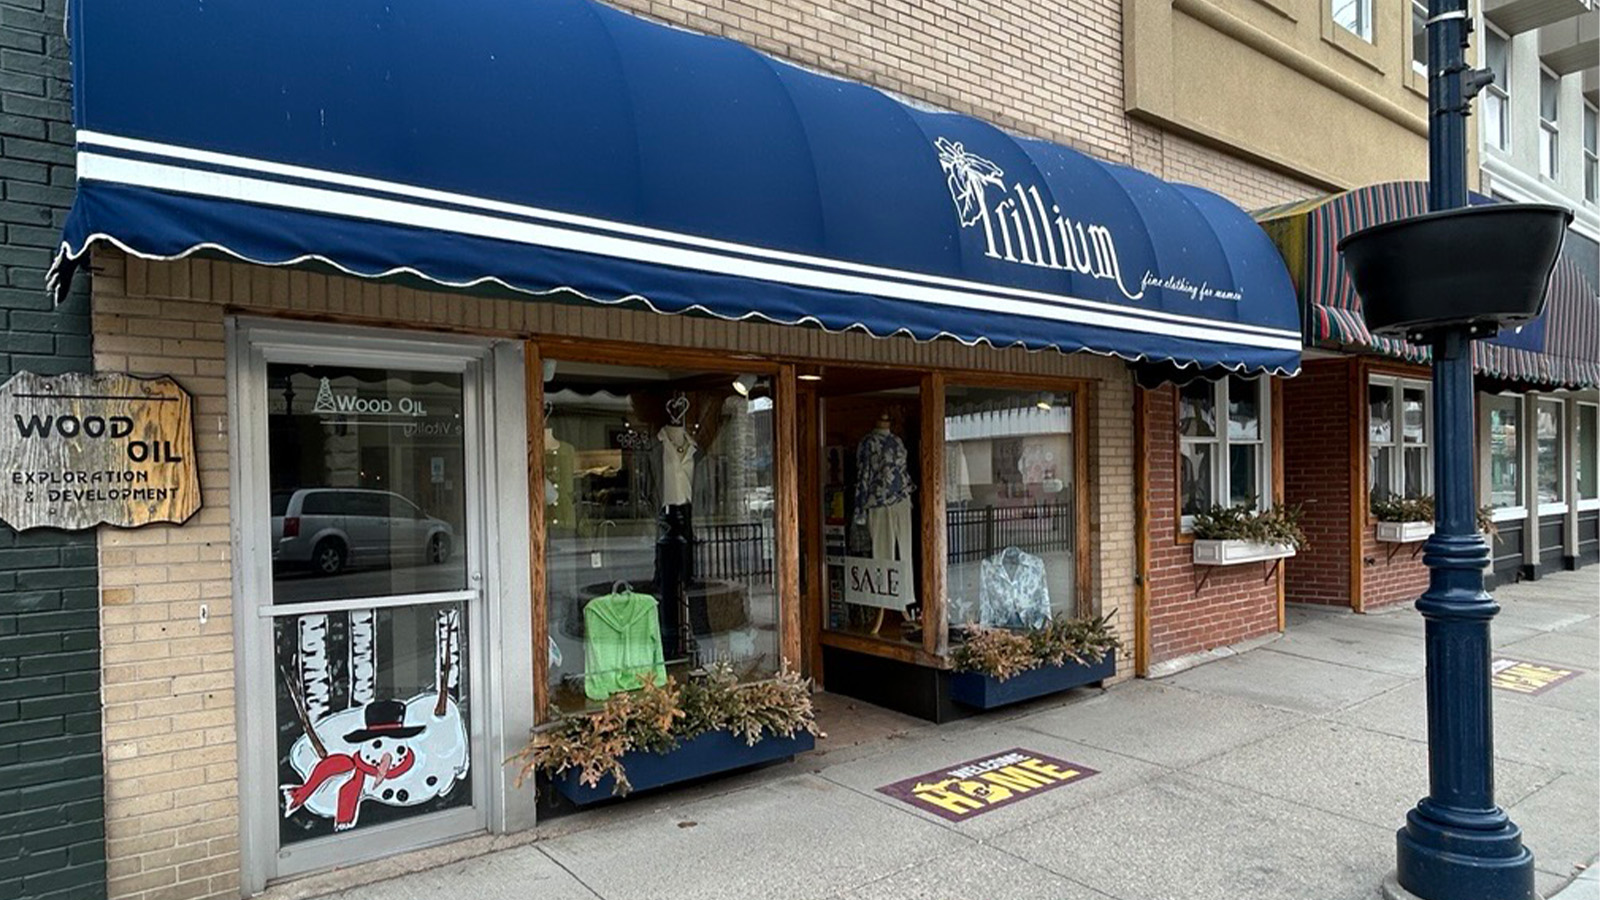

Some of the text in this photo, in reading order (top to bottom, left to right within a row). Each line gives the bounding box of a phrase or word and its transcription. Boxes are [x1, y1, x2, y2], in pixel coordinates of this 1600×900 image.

[950, 166, 1143, 300] Trillium
[1141, 269, 1163, 291] fine
[1163, 275, 1198, 300] clothing
[1199, 281, 1213, 301] for
[14, 414, 134, 438] WOOD
[127, 441, 182, 463] OIL
[12, 471, 148, 484] EXPLORATION
[25, 488, 179, 503] & DEVELOPMENT
[851, 566, 899, 597] SALE
[946, 752, 1030, 779] WELCOME
[914, 757, 1081, 815] HOME
